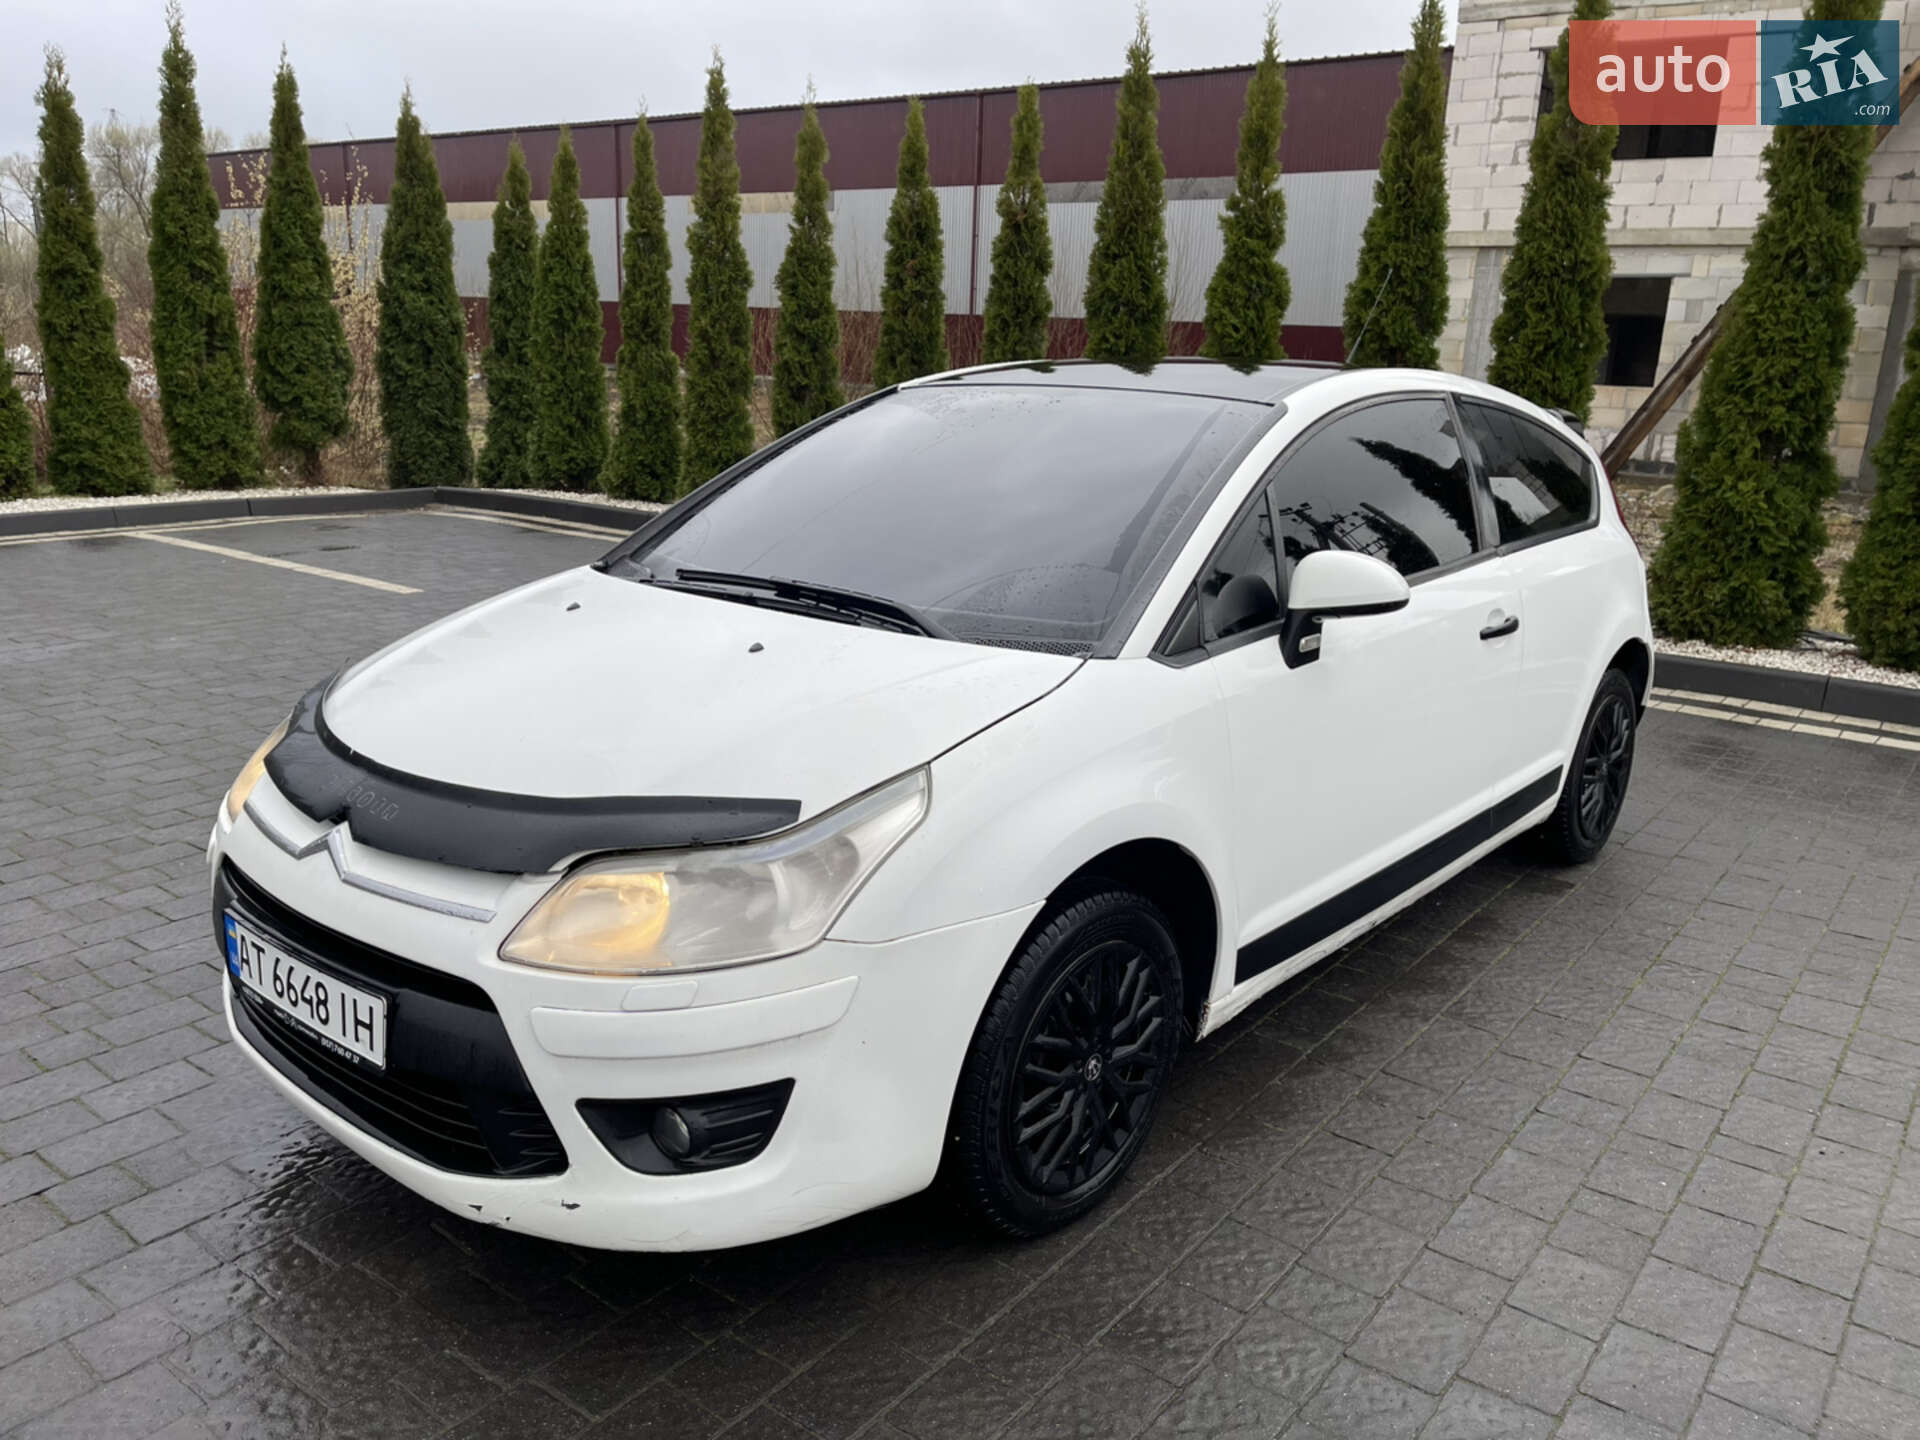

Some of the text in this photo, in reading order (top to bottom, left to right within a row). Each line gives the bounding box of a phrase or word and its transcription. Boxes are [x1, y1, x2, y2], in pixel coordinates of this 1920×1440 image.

[239, 933, 266, 986] AT
[272, 957, 330, 1026] 6648
[340, 991, 374, 1052] IH
